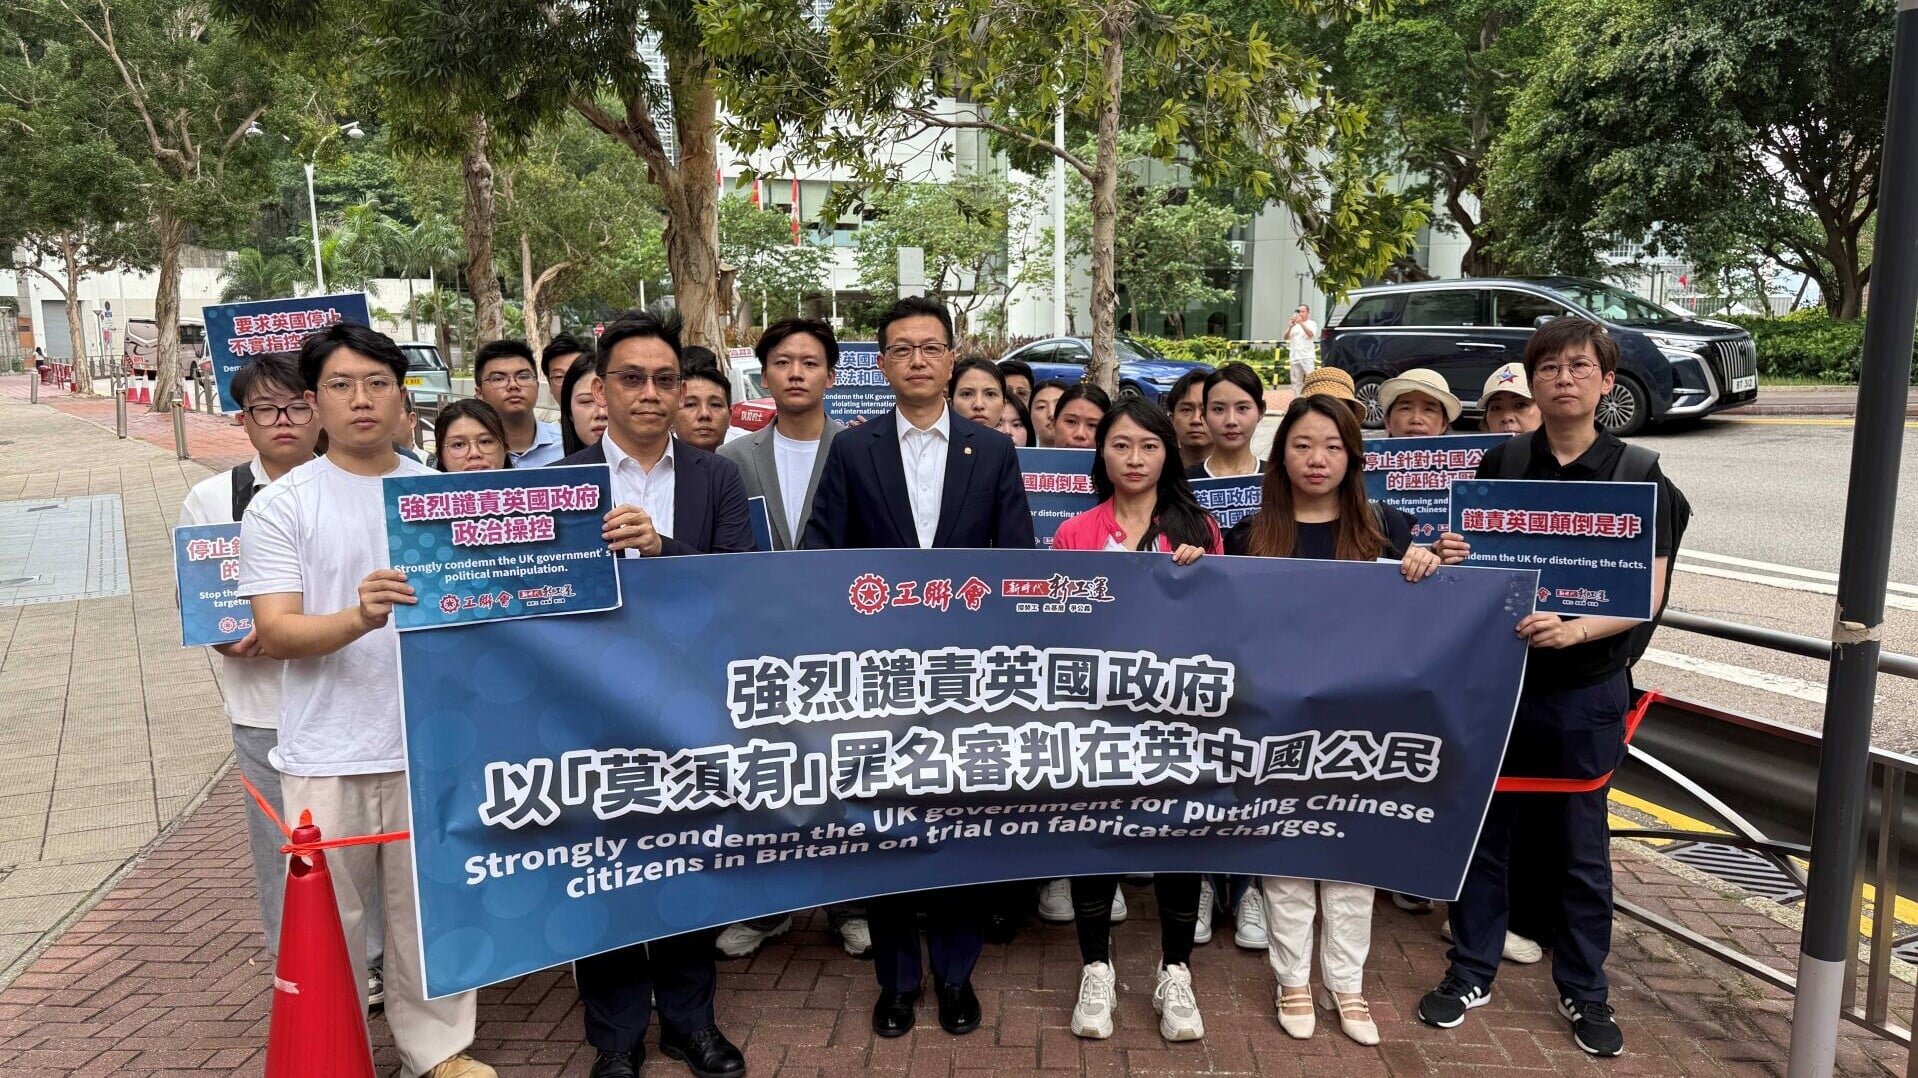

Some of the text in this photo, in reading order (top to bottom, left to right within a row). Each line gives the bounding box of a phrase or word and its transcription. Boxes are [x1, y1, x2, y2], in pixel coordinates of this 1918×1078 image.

[233, 308, 342, 336] 要求英國停止
[228, 331, 311, 356] 不實指控
[844, 407, 886, 415] international
[400, 484, 599, 521] 強烈譴責英國政府
[1401, 497, 1433, 506] framing
[1433, 497, 1449, 505] and
[452, 516, 555, 546] 政治操控
[1462, 509, 1642, 538] 譴責英國顛倒是非
[394, 559, 442, 575] Strongly
[445, 557, 495, 571] condemn
[498, 555, 517, 566] the
[519, 553, 535, 564] UK
[445, 563, 568, 584] political manipulation.
[1499, 554, 1514, 562] the
[1517, 555, 1532, 563] UK
[1533, 555, 1548, 564] for
[1549, 556, 1598, 568] distorting
[1600, 558, 1616, 567] the
[1618, 559, 1647, 570] facts.
[200, 590, 220, 601] Stop
[462, 591, 513, 608] 工聯會
[891, 576, 991, 611] 工聯會
[729, 648, 1233, 725] 強烈譴責英國政府
[480, 721, 1440, 828] 以「莫須有」罪名審判在英中國公民
[465, 794, 1436, 885] Strongly condemn the UK government for putting Chinese
[566, 815, 1346, 898] citizens in Britain on trial on fabricated charges.
